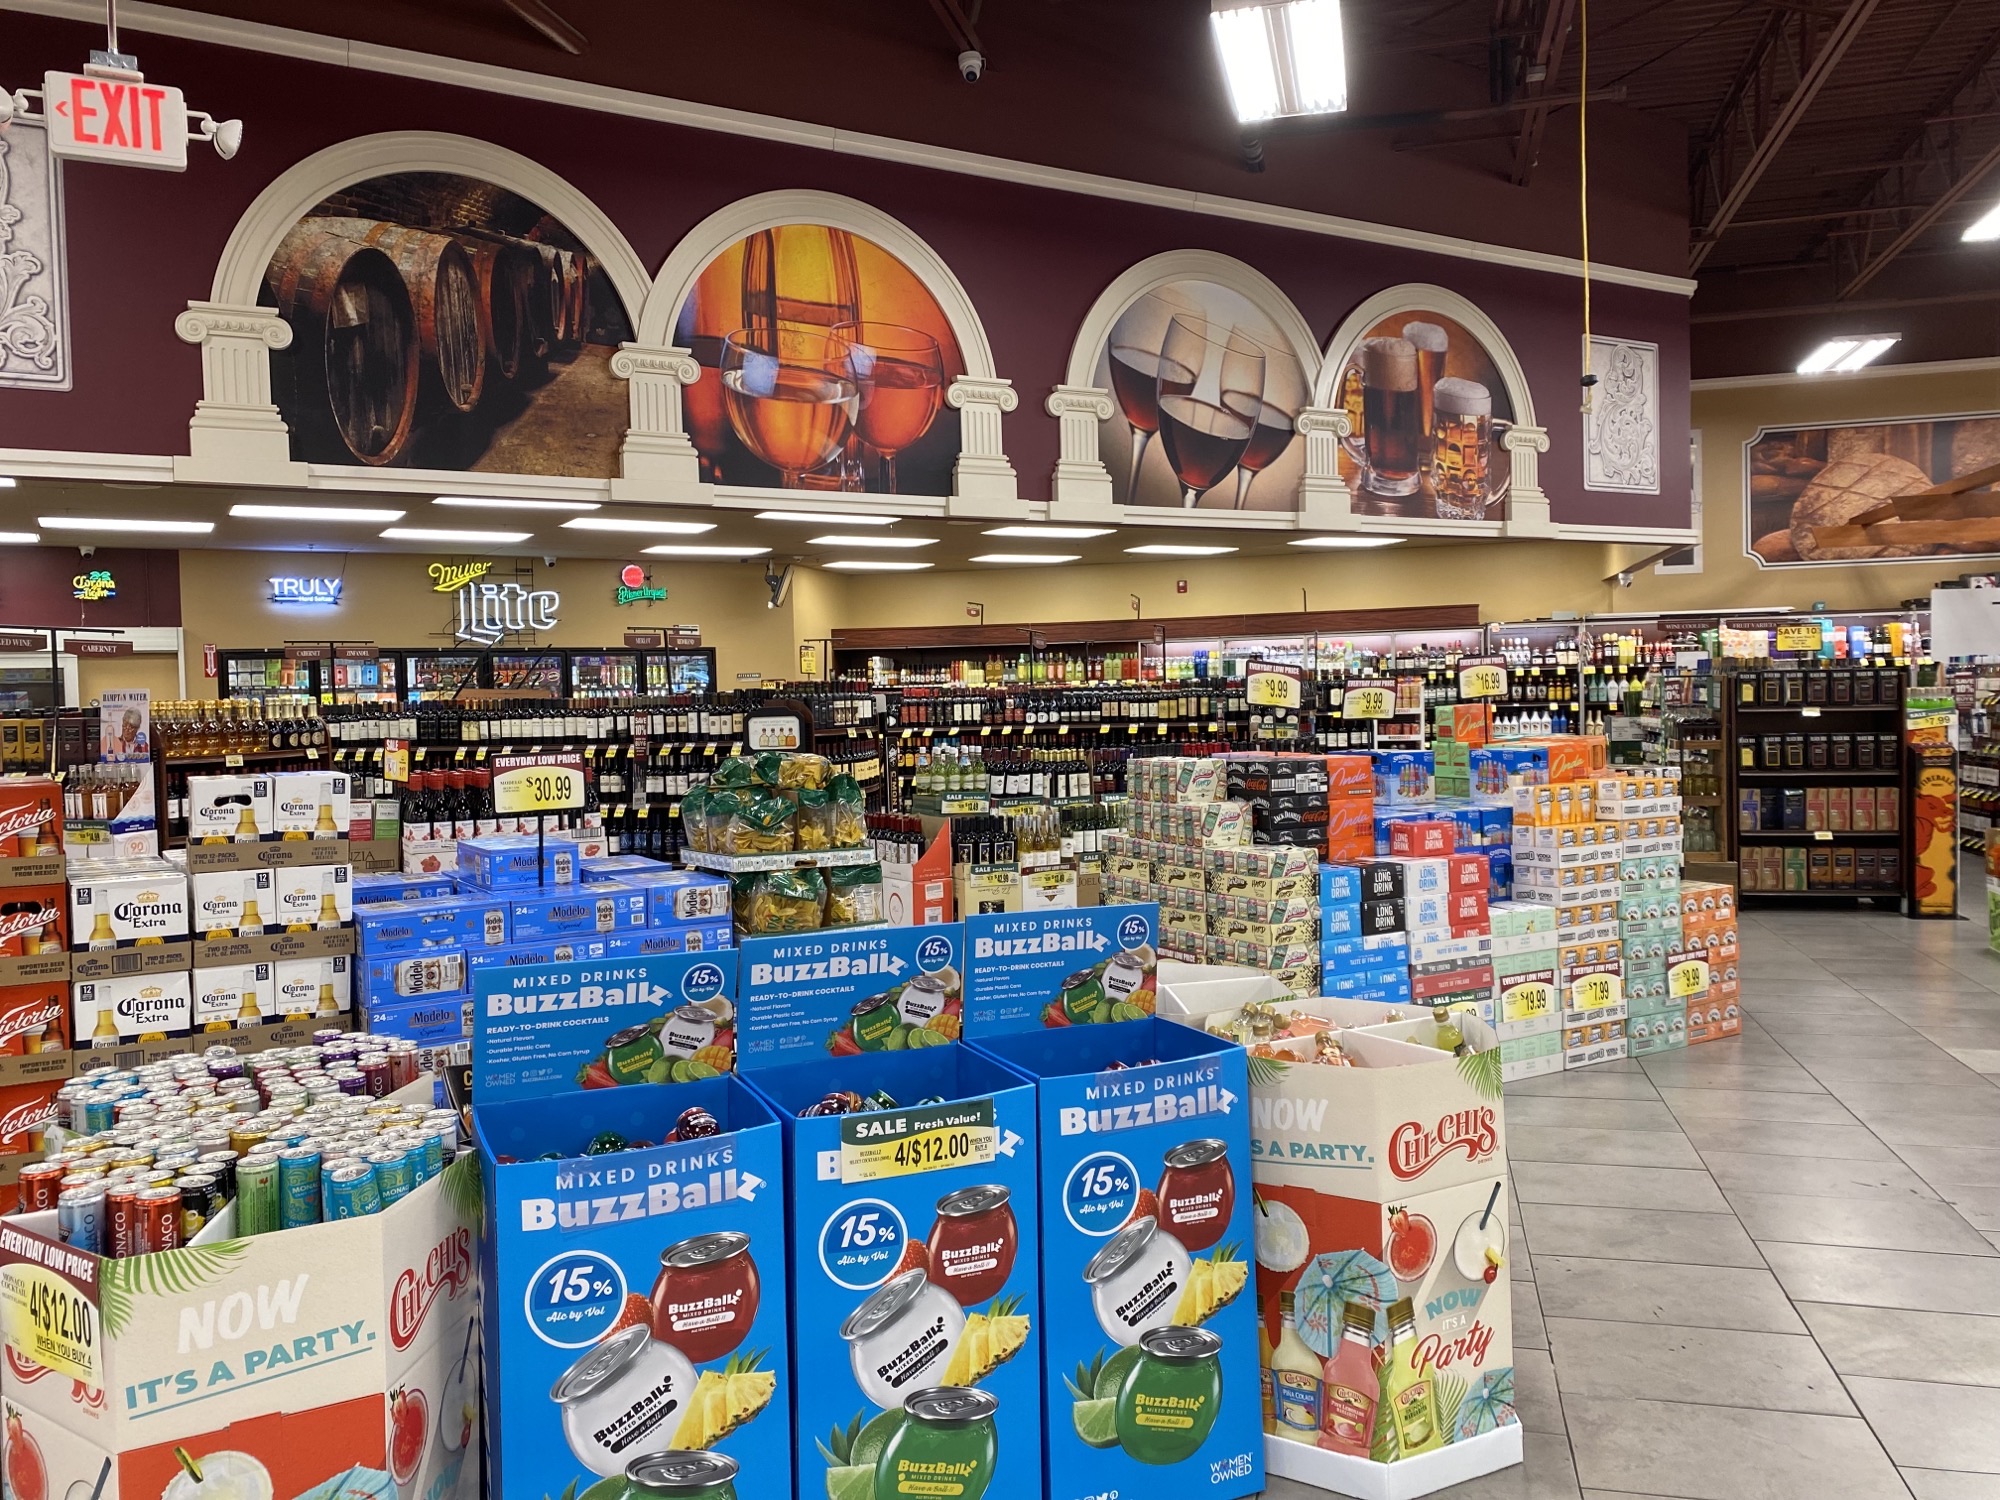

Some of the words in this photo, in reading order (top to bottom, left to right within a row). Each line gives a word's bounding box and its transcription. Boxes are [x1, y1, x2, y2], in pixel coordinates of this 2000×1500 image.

[71, 78, 166, 151] EXIT
[428, 562, 492, 590] Miller
[268, 577, 340, 596] TRULY
[455, 581, 559, 645] Lite
[1778, 627, 1802, 636] SAVE
[13, 639, 32, 647] WINE
[81, 644, 117, 653] CABERNET
[1249, 663, 1272, 673] EVERYDAY
[1272, 665, 1284, 673] LOW
[1284, 666, 1300, 675] PRICE
[1265, 679, 1288, 699] $9.99
[1475, 672, 1500, 691] $16.99
[129, 693, 147, 701] WATER
[1362, 691, 1383, 710] $9.99
[1925, 715, 1951, 726] $7.99
[386, 739, 398, 750] SALE
[495, 755, 537, 768] EVERYDAY
[537, 754, 556, 765] LOW
[557, 753, 581, 764] PRICE
[1330, 767, 1369, 787] Onda
[526, 775, 571, 802] $30.99
[200, 806, 235, 817] Corona
[1273, 812, 1285, 825] JACK
[1302, 810, 1329, 823] Coca-Cola
[130, 841, 144, 851] 90
[209, 851, 237, 859] 12-PACKS
[1374, 872, 1391, 883] LONG
[1419, 868, 1437, 878] LONG
[1461, 863, 1478, 874] LONG
[1331, 877, 1349, 888] LONG
[1373, 882, 1393, 893] DRINK
[1418, 877, 1438, 889] DRINK
[1460, 873, 1480, 884] DRINK
[79, 889, 89, 898] 12
[1330, 887, 1351, 898] DRINK
[114, 901, 183, 922] Corona
[515, 907, 528, 915] 24
[552, 906, 586, 919] Modelo
[133, 918, 167, 929] Extra
[381, 927, 409, 938] Modelo
[773, 945, 823, 959] MIXED
[831, 939, 887, 953] DRINKS
[1367, 955, 1383, 963] FINLAND
[409, 960, 424, 994] Modelo
[513, 973, 572, 988] MIXED
[581, 967, 647, 983] DRINKS
[690, 969, 719, 984] 15%
[751, 952, 906, 986] BuzzBallz
[1502, 975, 1526, 986] EVERYDAY
[1526, 973, 1537, 982] LOW
[1537, 970, 1552, 980] PRICE
[1682, 967, 1700, 987] $9.99
[487, 981, 666, 1017] BuzzBallz
[1520, 988, 1547, 1012] $19.99
[1588, 980, 1610, 1002] $7.99
[414, 1011, 450, 1023] Modelo
[486, 1021, 562, 1035] READY-TO-DRINK
[563, 1016, 610, 1028] COCKTAILS
[489, 1036, 513, 1045] Natural
[513, 1034, 535, 1042] Flavors
[488, 1046, 514, 1055] Durable
[514, 1044, 534, 1053] Plastic
[488, 1056, 510, 1065] Kosher,
[511, 1054, 532, 1063] Gluten
[533, 1052, 547, 1061] Free,
[548, 1051, 557, 1059] No
[573, 1048, 590, 1058] Syrup
[485, 1079, 516, 1087] OWNED
[1086, 1081, 1146, 1100] MIXED
[1154, 1067, 1214, 1090] DRINKS
[1060, 1084, 1236, 1136] BuzzBallz
[1253, 1096, 1329, 1133] NOW
[855, 1117, 907, 1138] SALE
[914, 1117, 944, 1131] Fresh
[945, 1111, 981, 1126] Value!
[894, 1132, 969, 1167] 4/$12.00
[969, 1138, 981, 1146] WHEN
[981, 1136, 993, 1144] YOU
[1269, 1140, 1285, 1158] A
[1290, 1142, 1375, 1163] PARTY.
[555, 1166, 636, 1190] MIXED
[648, 1149, 734, 1179] DRINKS
[1081, 1164, 1130, 1198] 15%
[521, 1168, 763, 1232] BuzzBallz
[839, 1212, 896, 1248] 15%
[0, 1228, 45, 1264] EVERYDAY
[44, 1246, 65, 1272] LOW
[65, 1253, 95, 1283] PRICE
[1, 1280, 27, 1298] COCKTAIL
[2, 1272, 25, 1288] MONACO
[548, 1265, 613, 1304] 15%
[668, 1292, 740, 1315] BuzzBallz
[1425, 1288, 1483, 1321] NOW
[29, 1279, 92, 1348] 4/$12.00
[176, 1273, 310, 1354] NOW
[546, 1310, 567, 1322] Alc
[568, 1308, 584, 1322] by
[584, 1306, 606, 1318] Vol
[1441, 1318, 1458, 1331] IT'S
[1458, 1316, 1466, 1326] A
[36, 1334, 56, 1352] WHEN
[56, 1343, 71, 1358] YOU
[72, 1348, 86, 1363] BUY
[87, 1354, 92, 1366] 4
[1410, 1319, 1495, 1378] Party
[125, 1368, 198, 1410] IT'S
[207, 1360, 235, 1386] A
[244, 1319, 376, 1375] PARTY.
[1295, 1391, 1315, 1401] COLADA
[1210, 1464, 1252, 1484] OWNED
